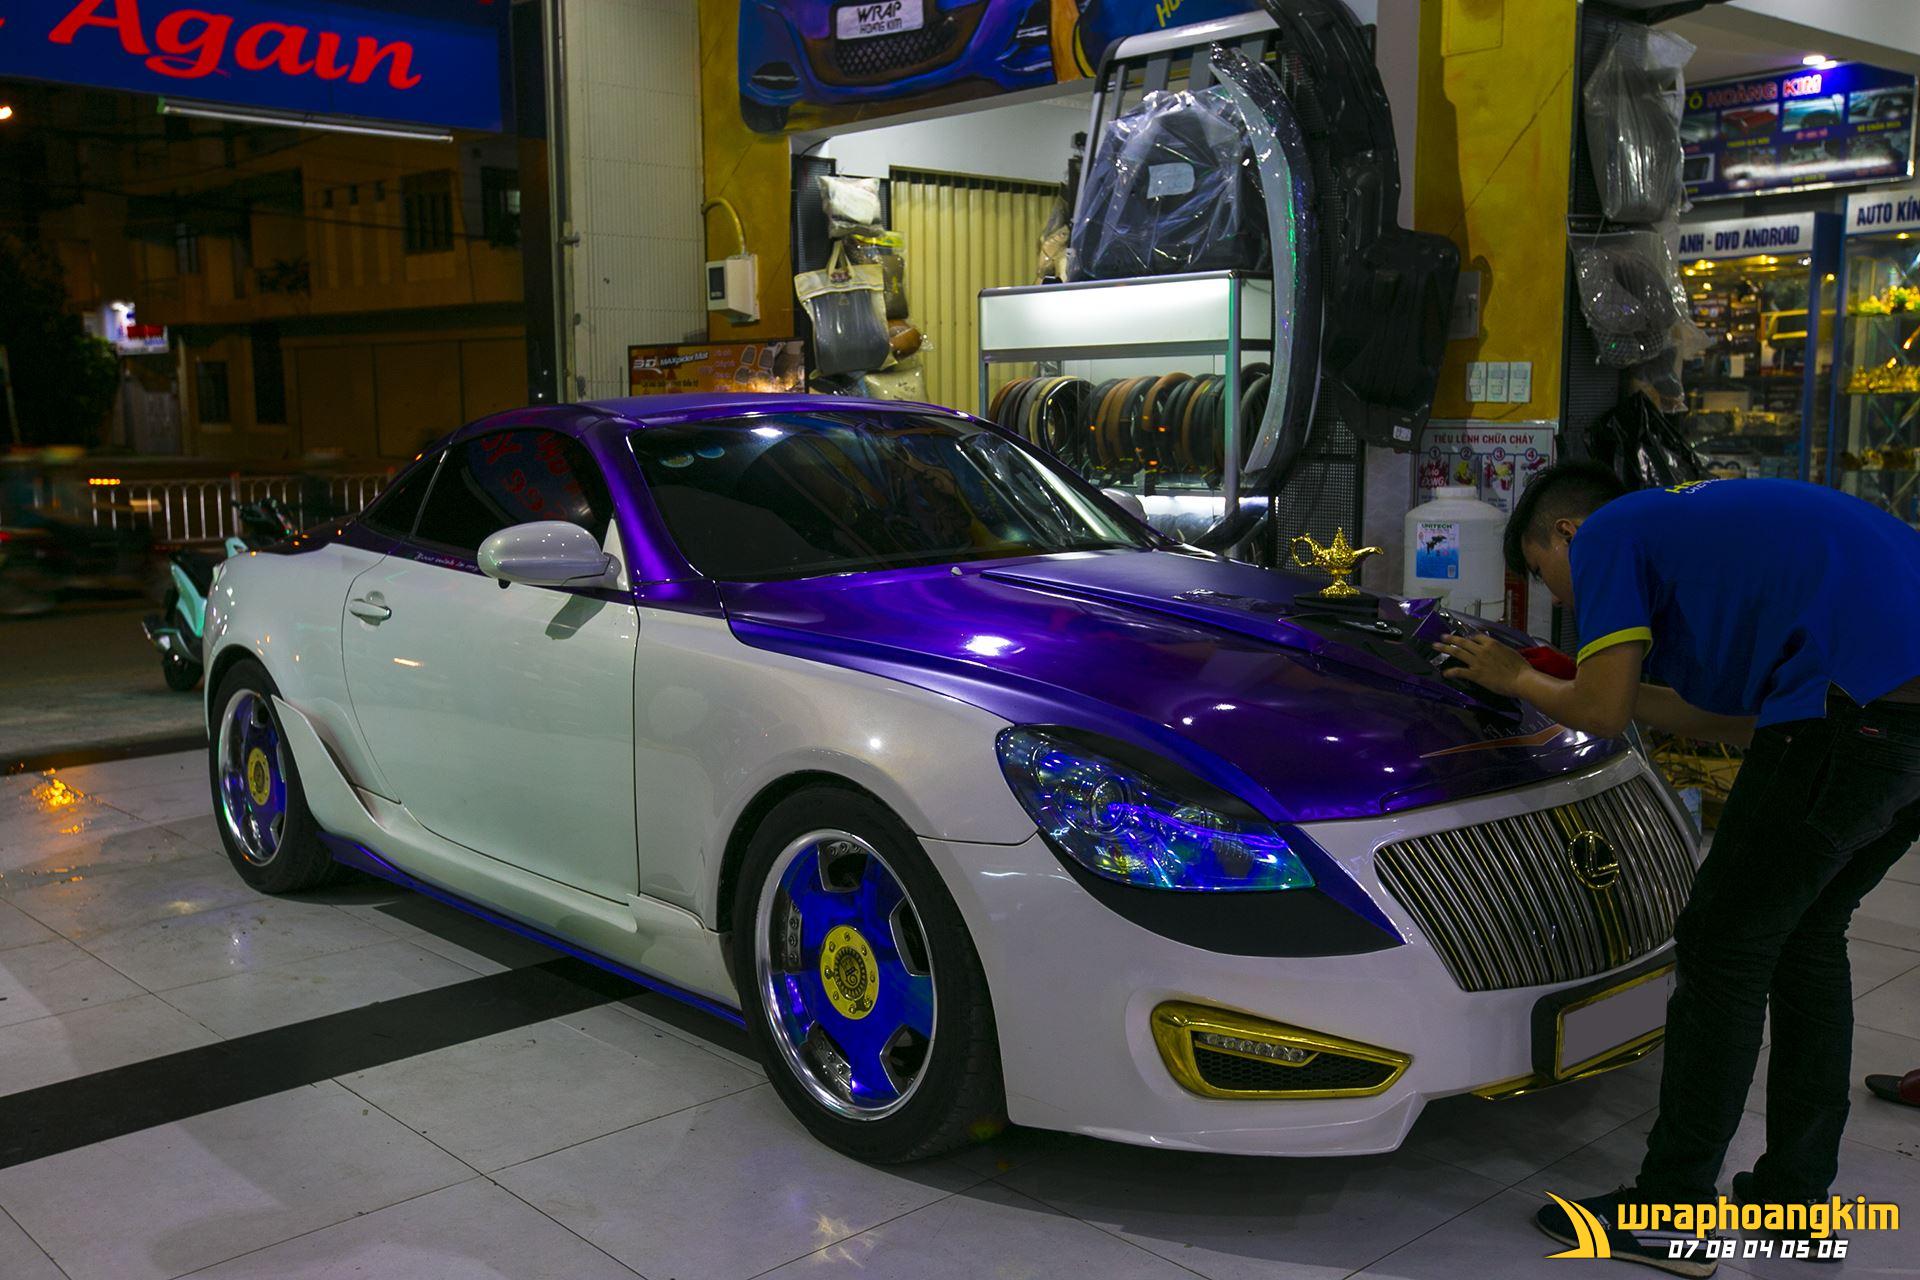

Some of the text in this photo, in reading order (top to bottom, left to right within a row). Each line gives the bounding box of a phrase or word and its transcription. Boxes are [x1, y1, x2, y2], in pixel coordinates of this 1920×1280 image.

[857, 1, 902, 22] WRAP
[48, 0, 423, 89] Again
[1686, 91, 1703, 110] Ô
[1782, 74, 1822, 97] KIM
[1857, 195, 1920, 226] AUTO KÍN
[1678, 234, 1704, 253] ANH
[1715, 232, 1740, 251] DVD
[1743, 225, 1800, 249] ANDROID
